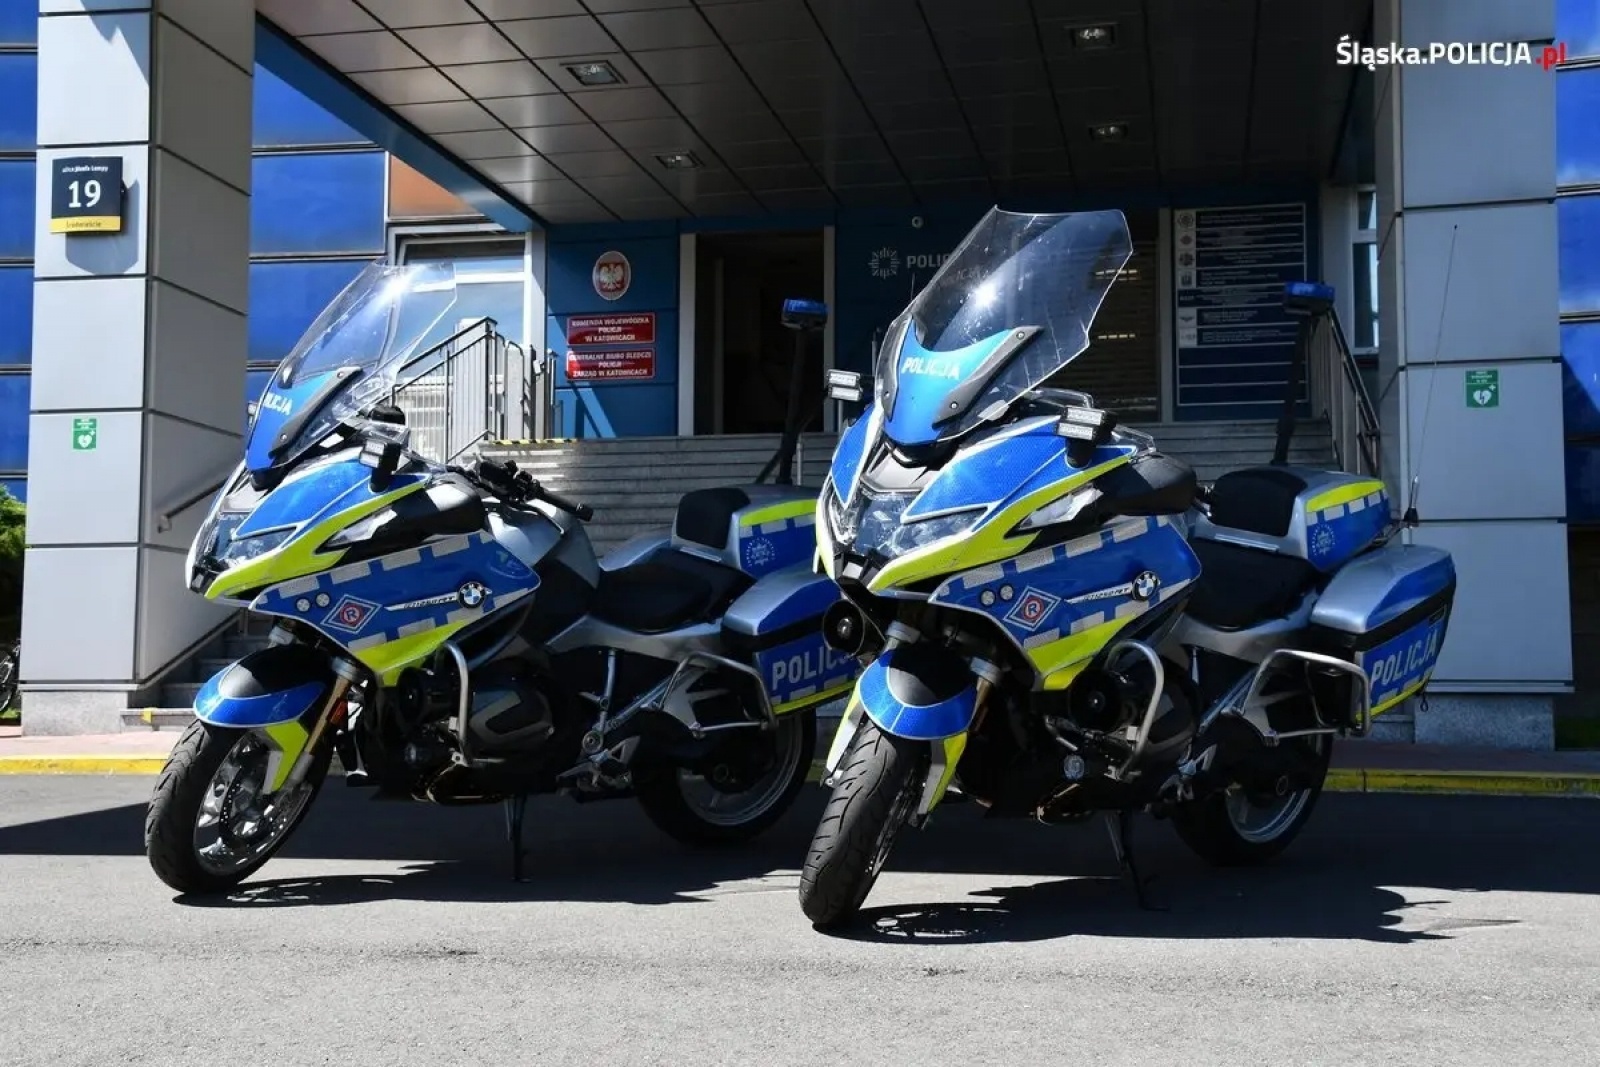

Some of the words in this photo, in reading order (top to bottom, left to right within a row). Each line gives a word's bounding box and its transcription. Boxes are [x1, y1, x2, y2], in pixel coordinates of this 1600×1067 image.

[68, 179, 101, 208] 19
[593, 334, 636, 342] KATOWICACH
[901, 356, 960, 380] POLICJA
[772, 645, 846, 691] POLIC
[1370, 629, 1438, 690] POLICJA
